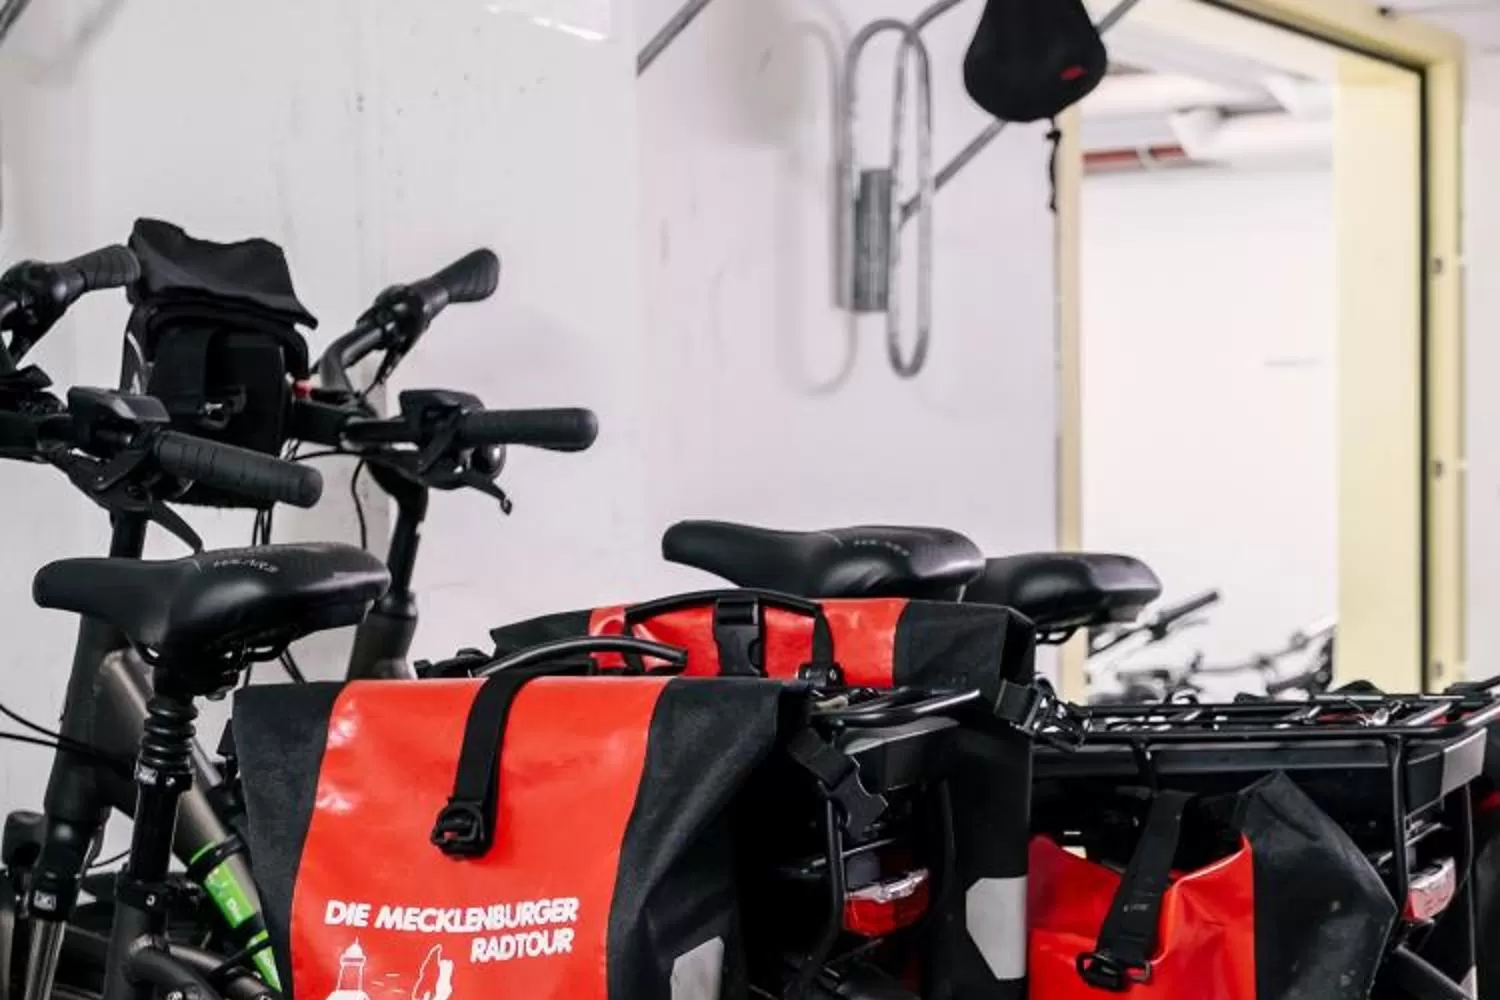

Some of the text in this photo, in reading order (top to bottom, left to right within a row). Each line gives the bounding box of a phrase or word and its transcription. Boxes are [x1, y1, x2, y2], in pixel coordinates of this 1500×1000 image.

[325, 897, 580, 933] DIE MECKLENBURGER
[470, 928, 576, 963] RADTOUR
